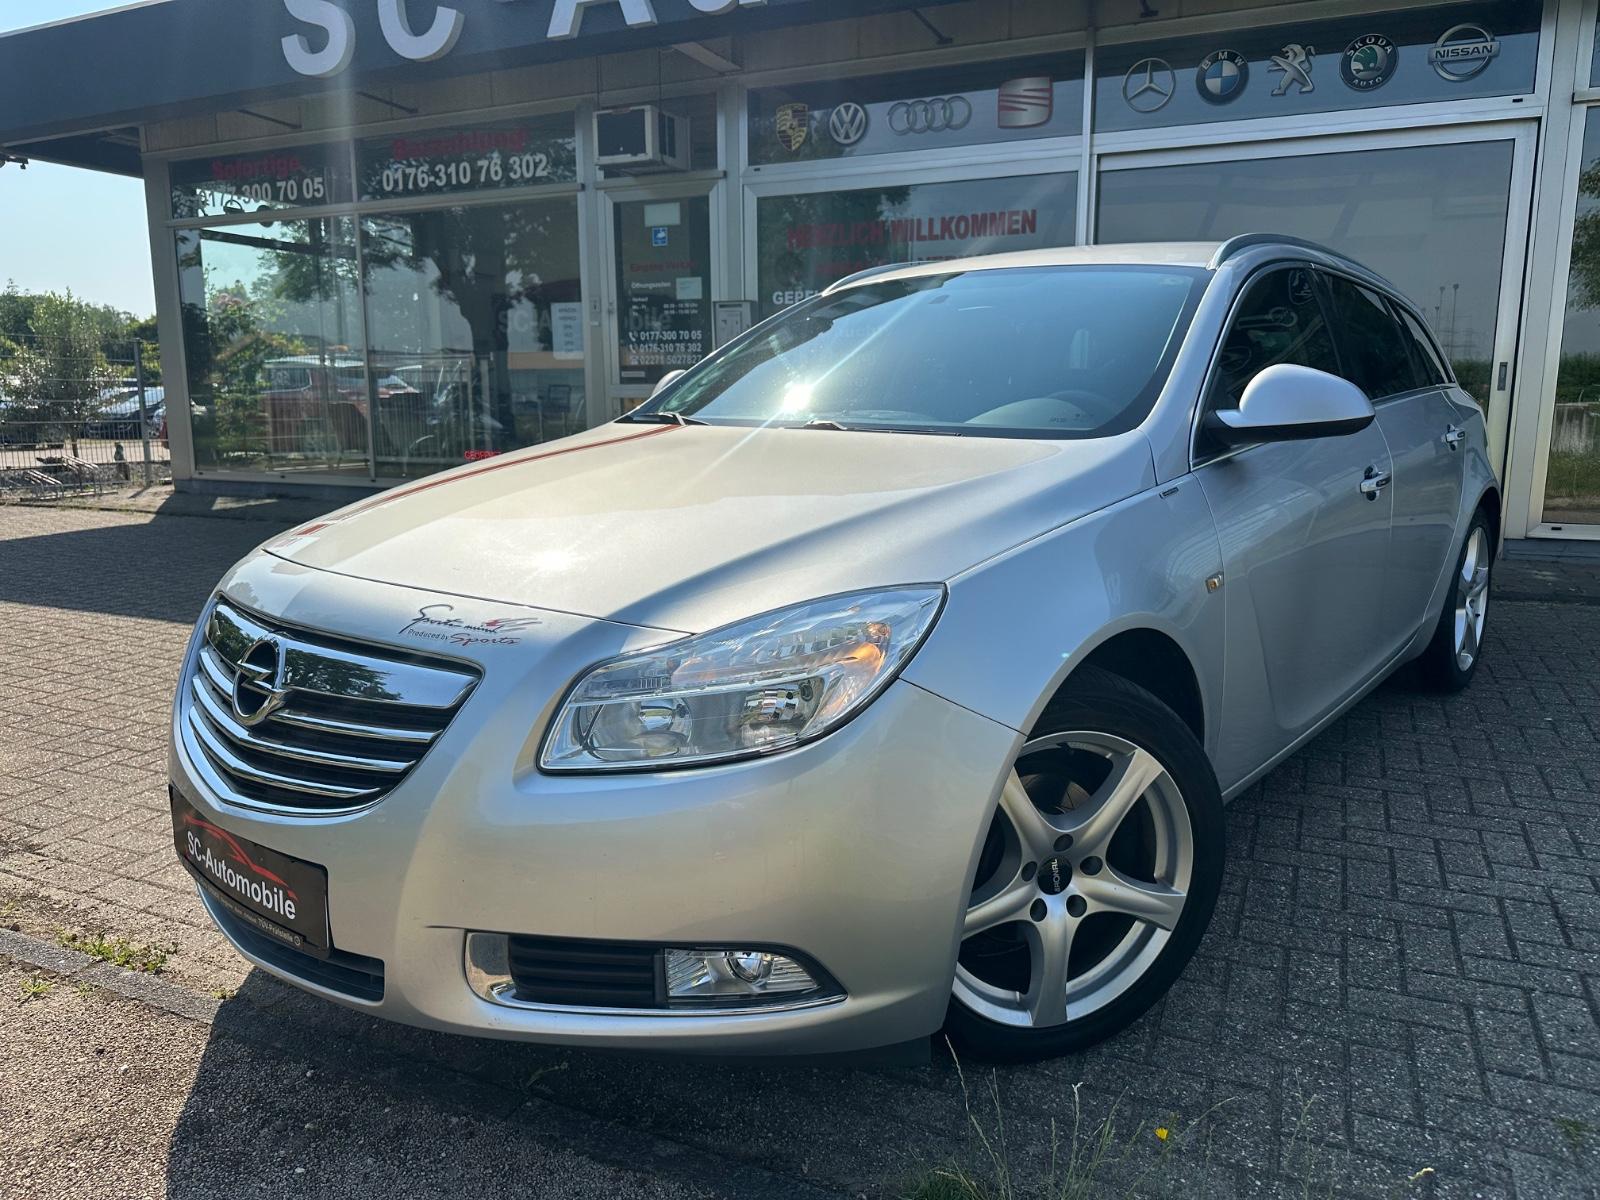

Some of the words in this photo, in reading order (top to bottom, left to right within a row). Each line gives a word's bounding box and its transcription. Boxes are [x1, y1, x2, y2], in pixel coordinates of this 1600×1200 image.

[1201, 51, 1245, 70] BMW
[1435, 44, 1493, 59] NISSAN
[1353, 76, 1382, 87] AUTO
[382, 161, 471, 192] 0176-310
[509, 153, 549, 180] 302
[276, 180, 298, 202] 70
[303, 177, 325, 199] 05
[787, 219, 885, 249] HERZLICH
[891, 208, 1037, 243] WILLKOMMEN
[640, 331, 677, 340] 0177-300
[680, 331, 690, 340] 70
[691, 330, 702, 340] 05
[408, 628, 440, 639] Produced
[450, 633, 521, 646] Sports
[187, 830, 296, 920] SC-Automobile
